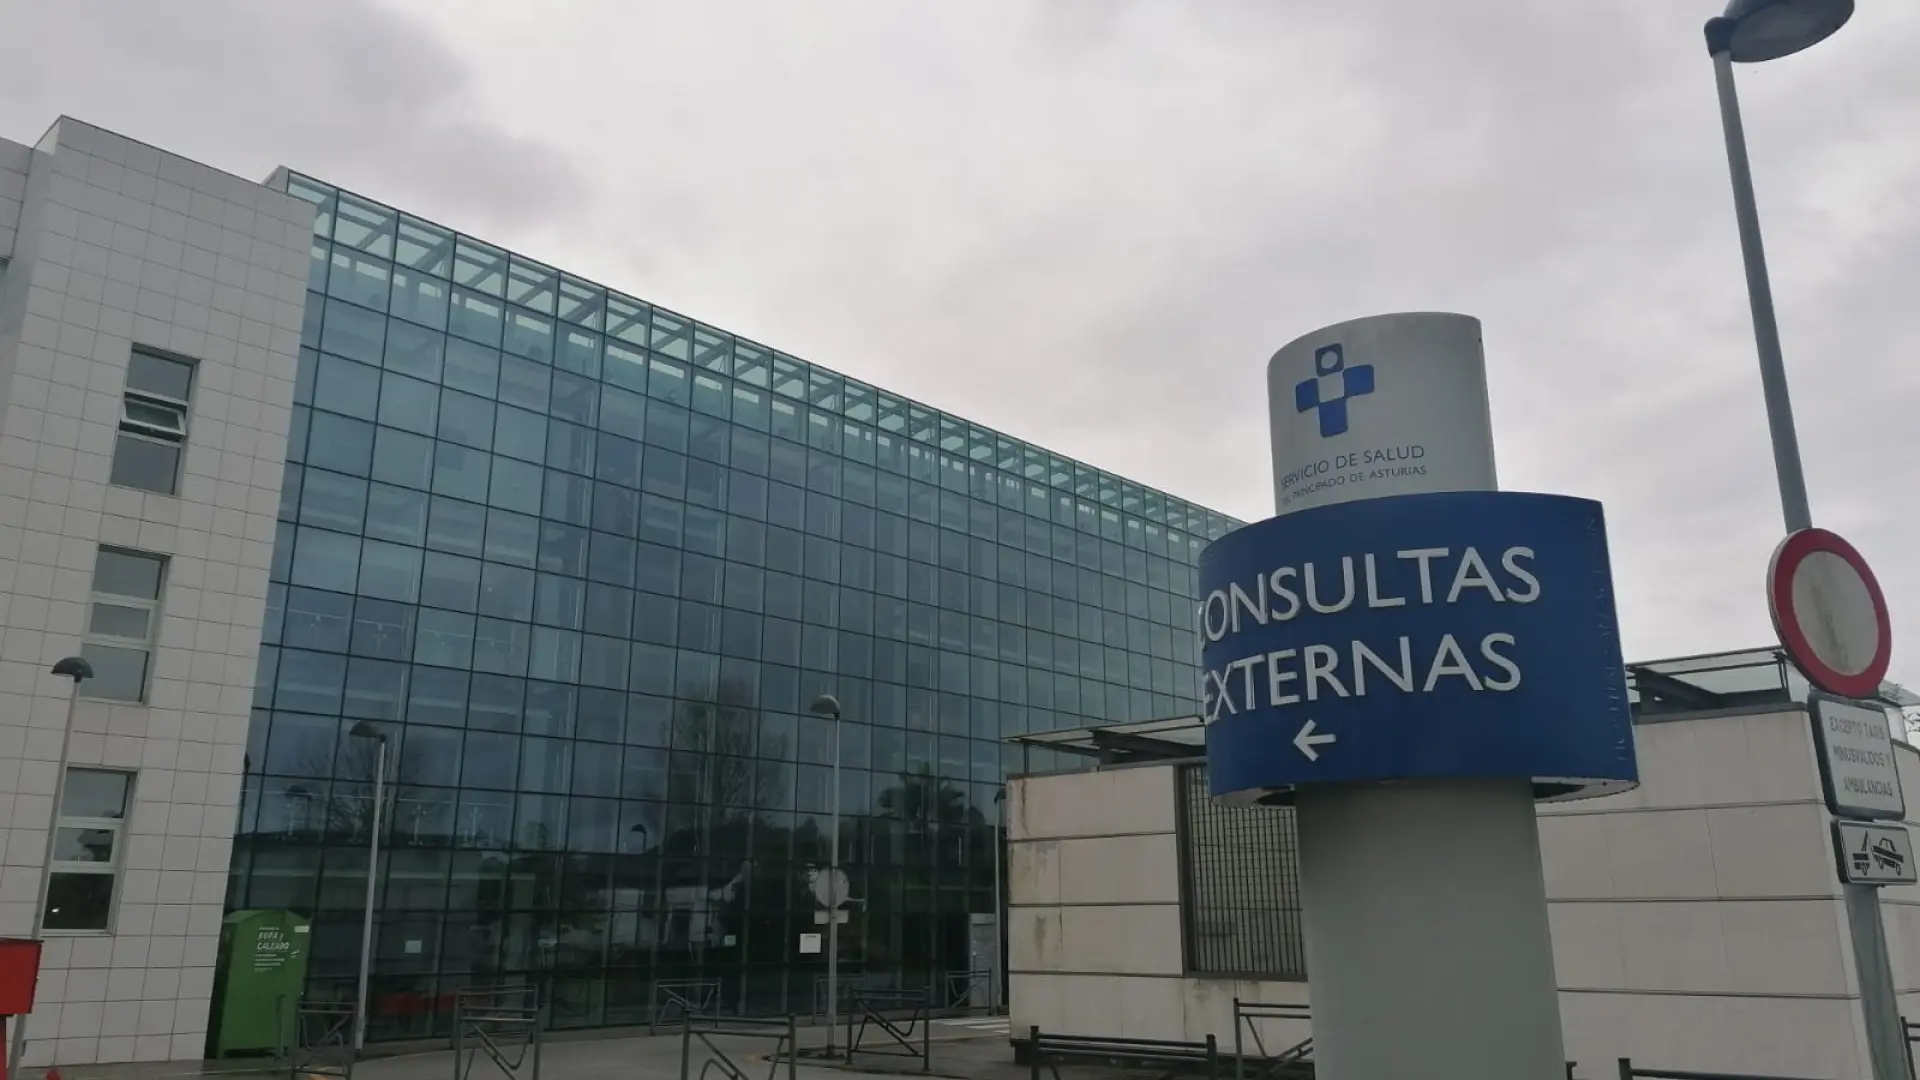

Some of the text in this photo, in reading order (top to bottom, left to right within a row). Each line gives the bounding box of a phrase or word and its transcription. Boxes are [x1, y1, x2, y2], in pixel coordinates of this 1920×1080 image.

[1281, 445, 1425, 491] SERVICIO DE SALUD
[1350, 472, 1365, 482] DE
[1369, 465, 1427, 480] ASTURIAS
[1203, 633, 1521, 725] EXTERNAS
[1829, 716, 1885, 740] EXCEPTO TAXIS
